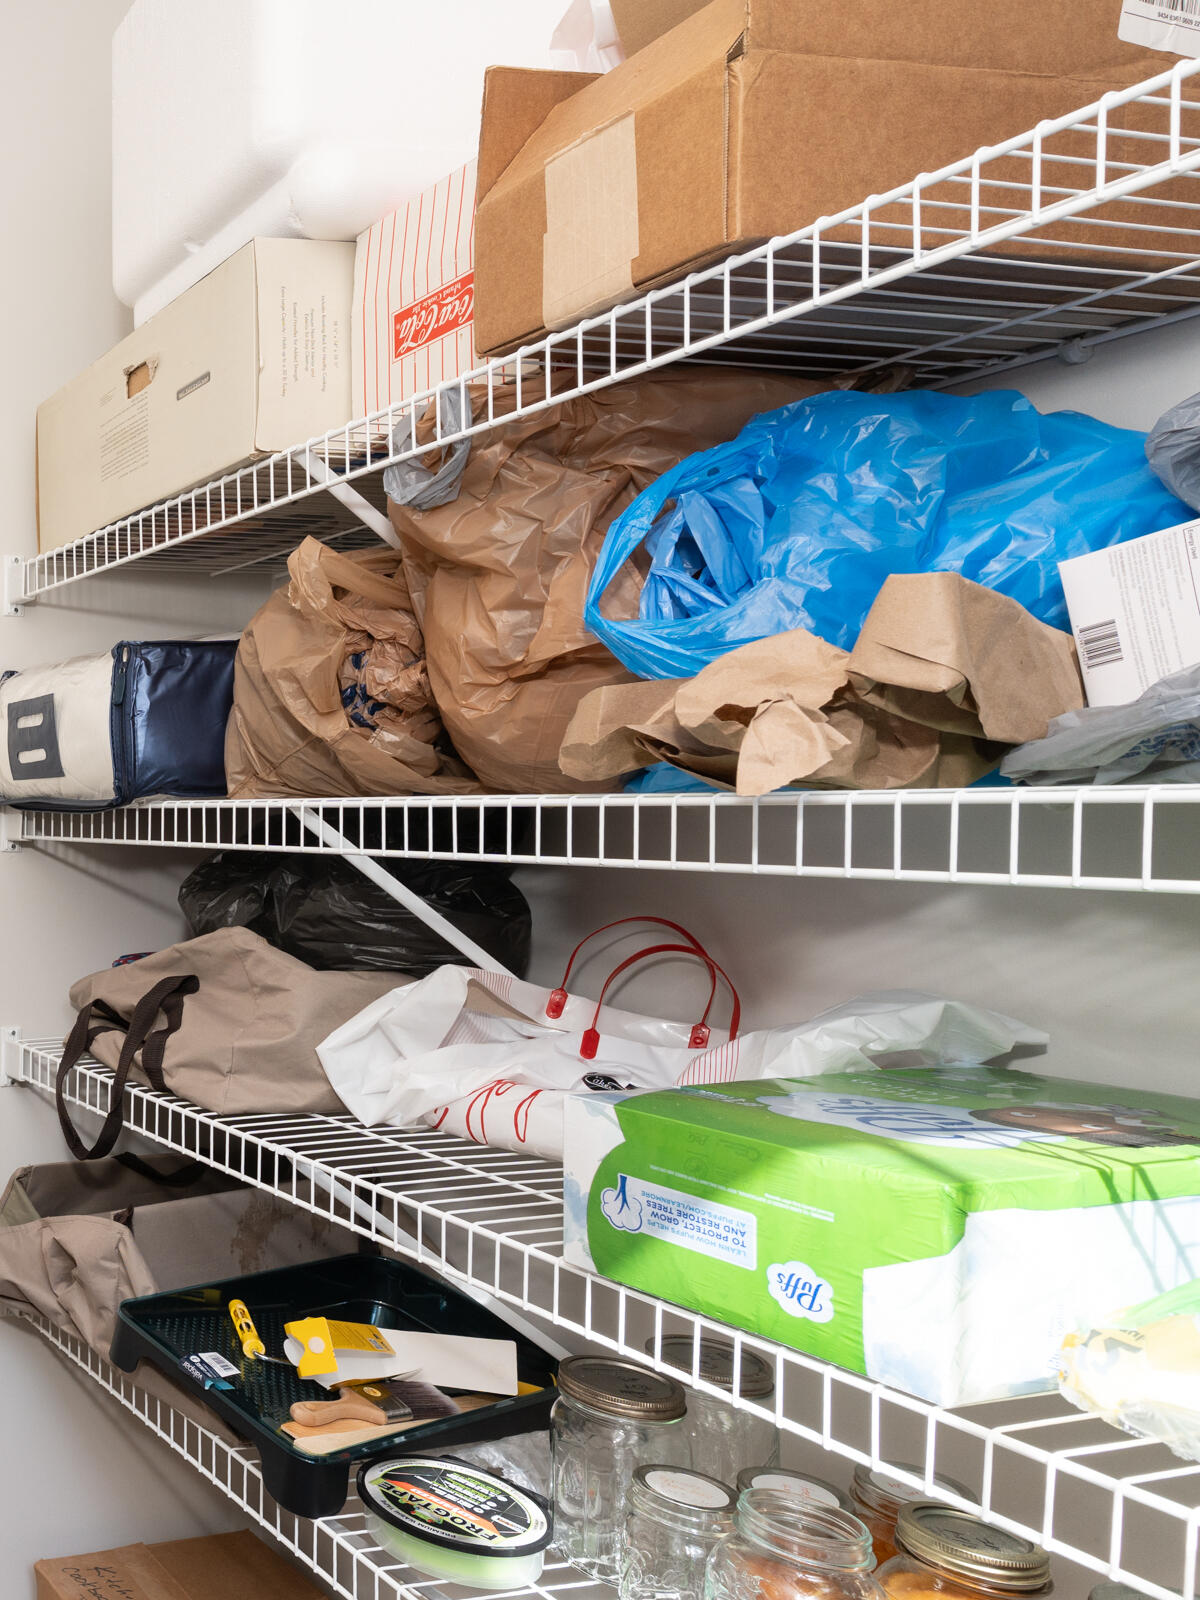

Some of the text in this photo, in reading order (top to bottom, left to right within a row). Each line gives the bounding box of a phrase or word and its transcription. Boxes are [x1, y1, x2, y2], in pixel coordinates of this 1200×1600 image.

[817, 1098, 1030, 1140] Puffs
[646, 1199, 746, 1238] AND RESTORE TREES
[650, 1210, 746, 1248] TO PROTECT, GROW
[647, 1219, 746, 1257] LEARN HOW PUFFS HELPS
[776, 1271, 823, 1313] Puffs
[182, 1361, 203, 1381] valspar
[378, 1482, 498, 1540] FROGTAPE
[418, 1524, 456, 1539] PREMIUM
